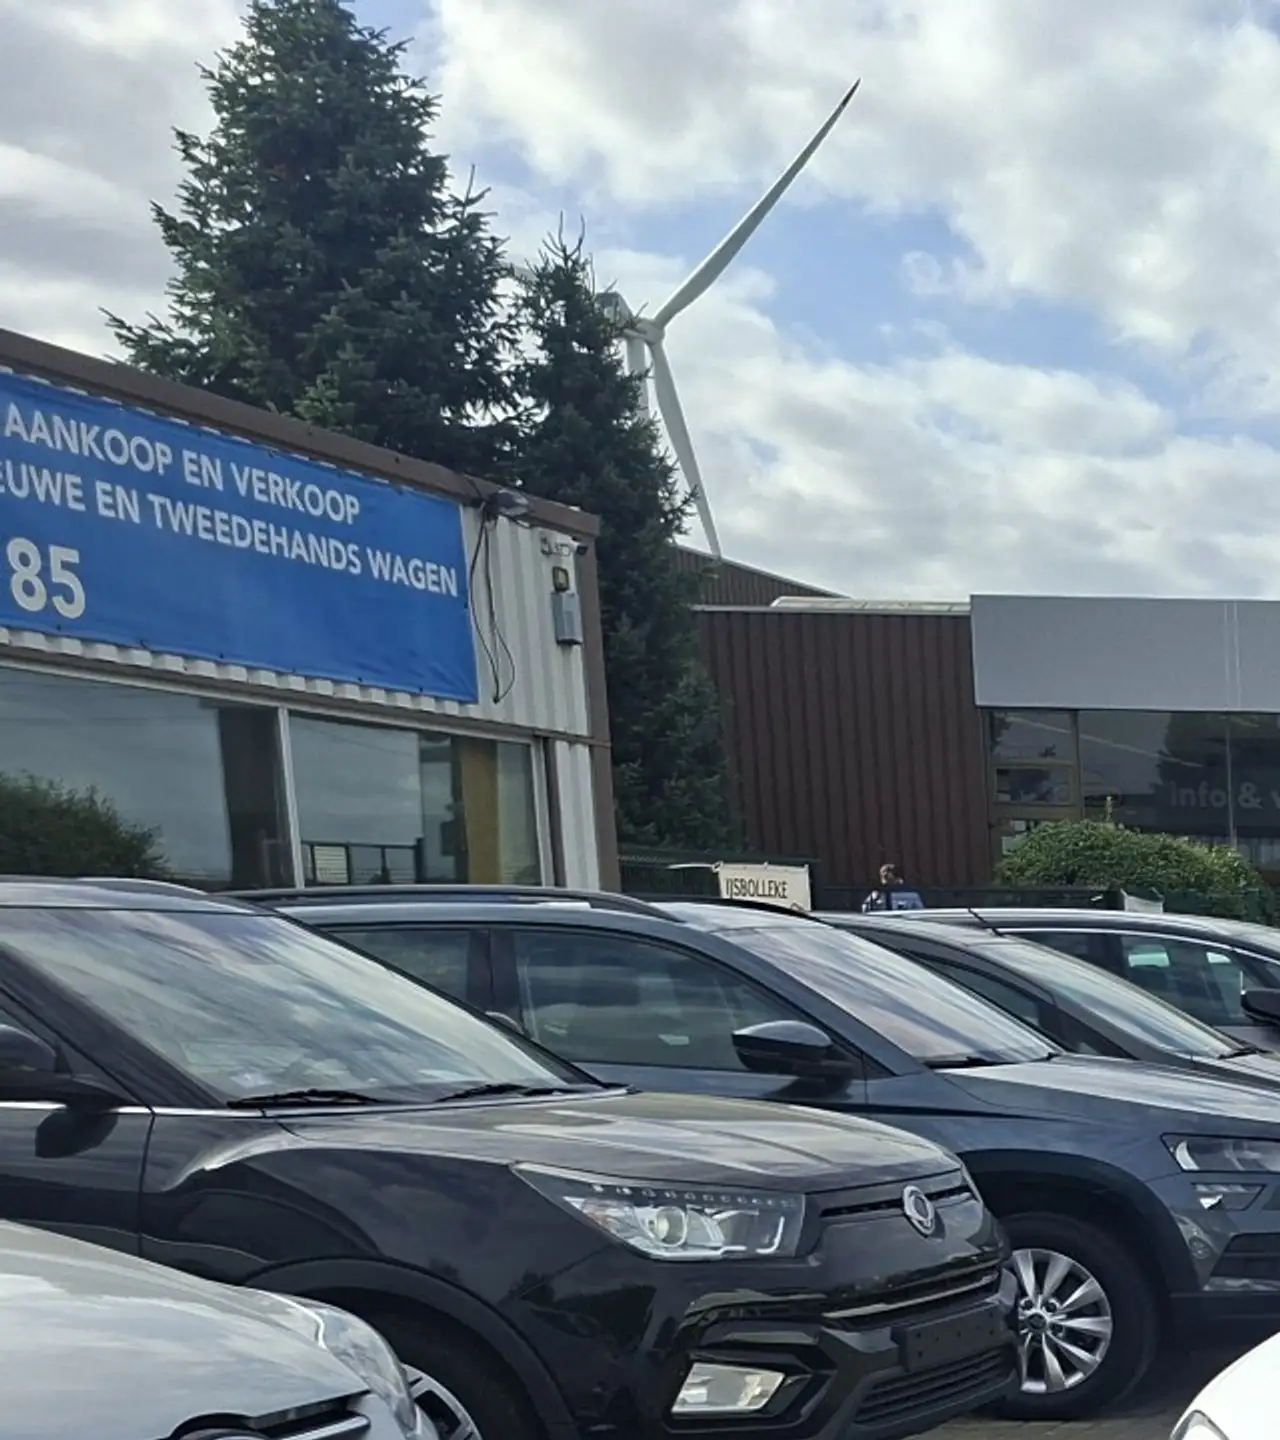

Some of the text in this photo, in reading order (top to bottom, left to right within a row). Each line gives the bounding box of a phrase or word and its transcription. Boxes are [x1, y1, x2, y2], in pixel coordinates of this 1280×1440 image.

[4, 402, 360, 525] AANKOOP EN VERKOOP
[0, 459, 459, 597] UWE EN TWEEDEHANDS WAGEN
[6, 536, 86, 619] 85
[1238, 781, 1264, 809] &
